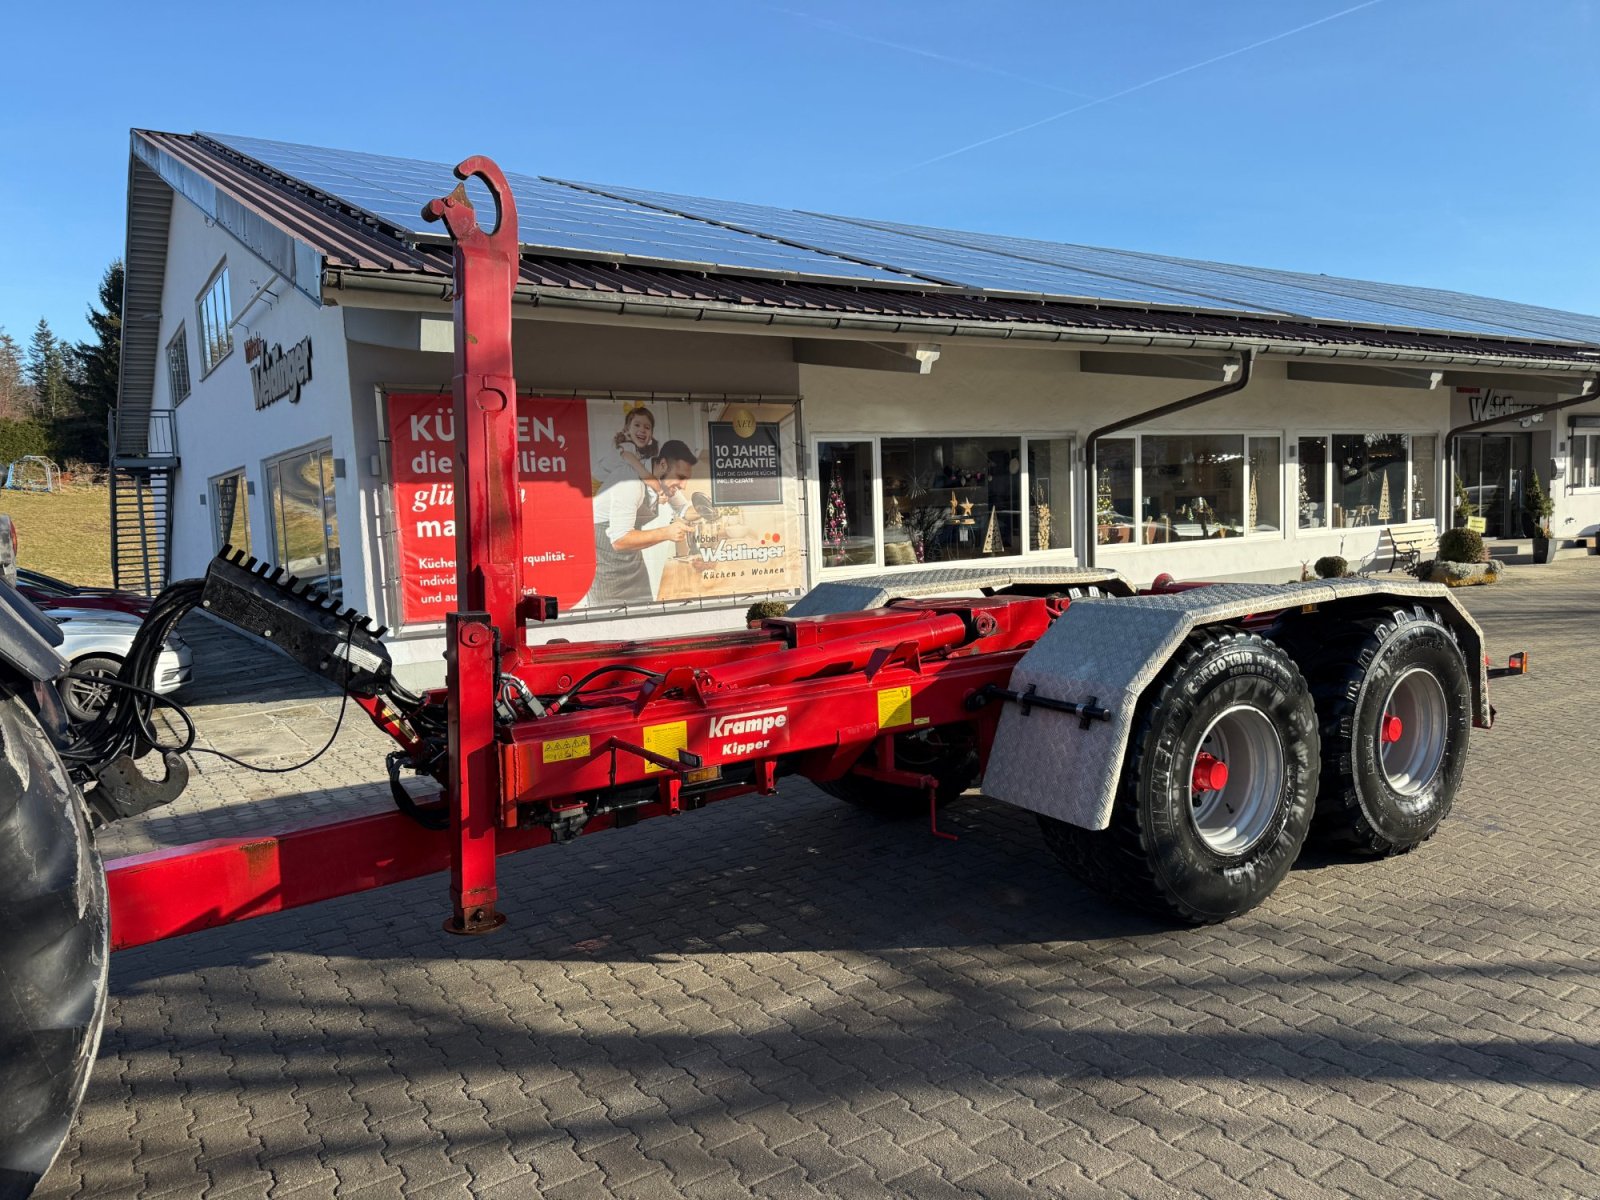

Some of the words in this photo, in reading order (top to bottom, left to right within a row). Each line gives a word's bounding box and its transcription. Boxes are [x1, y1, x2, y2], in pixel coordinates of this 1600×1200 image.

[410, 408, 566, 448] KÜEN,
[715, 445, 730, 457] 10
[732, 445, 776, 457] JAHRE
[411, 450, 453, 474] die
[715, 458, 777, 469] GARANTIE
[693, 533, 719, 544] Möbel
[700, 539, 785, 563] Weidinger
[703, 570, 737, 580] Küchen
[751, 567, 785, 575] Wohnen
[419, 575, 457, 587] individ
[420, 591, 442, 604] und
[445, 593, 458, 602] au
[708, 706, 788, 738] Krampe
[722, 740, 771, 756] Kipper
